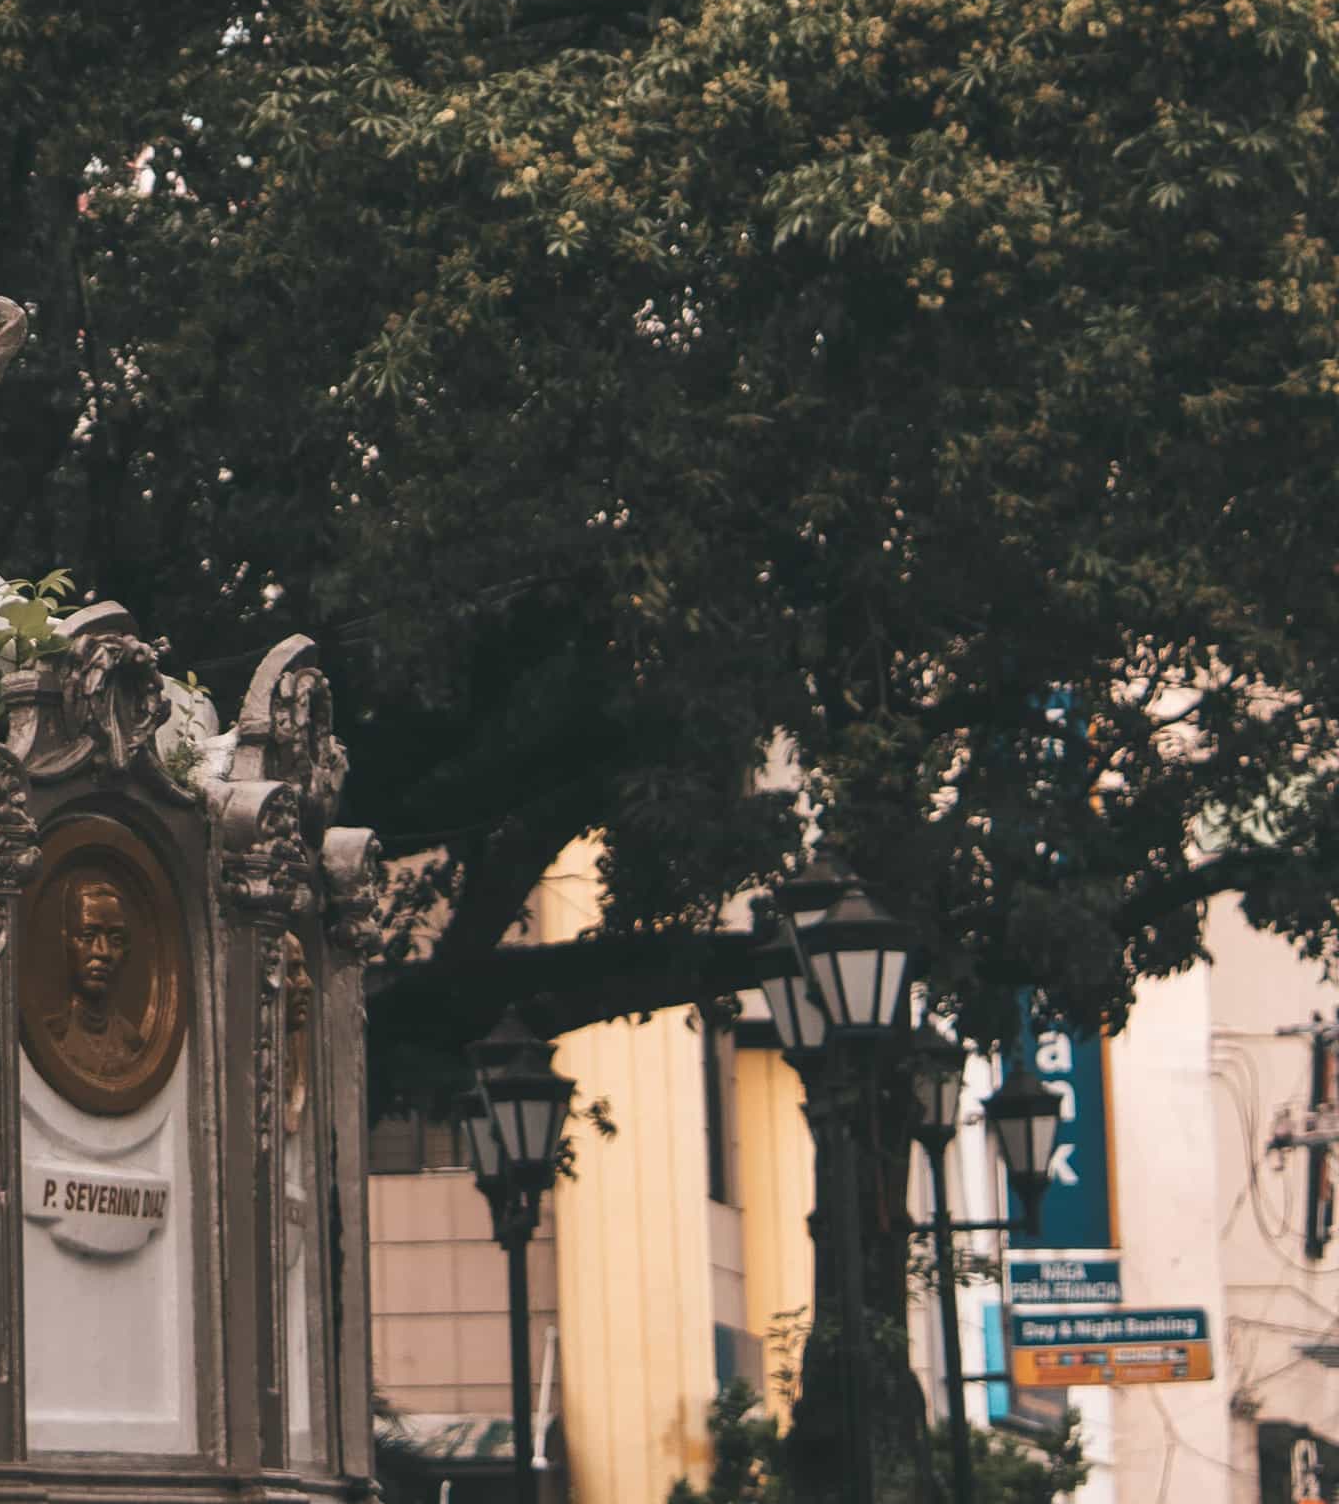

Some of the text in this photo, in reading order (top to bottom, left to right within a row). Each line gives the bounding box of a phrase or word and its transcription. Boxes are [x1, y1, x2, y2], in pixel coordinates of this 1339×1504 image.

[42, 1179, 167, 1219] P. SEVERINO DIAZ
[1022, 1316, 1198, 1341] Day & Night Banking
